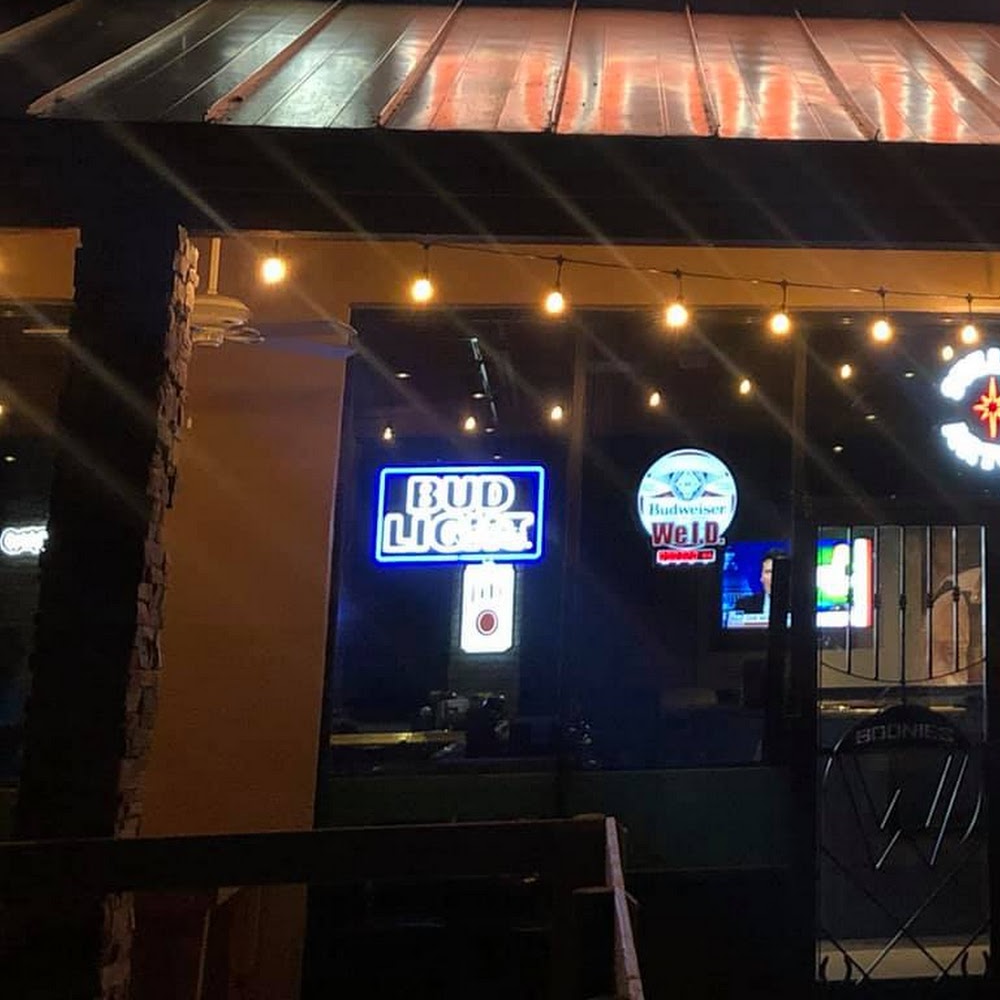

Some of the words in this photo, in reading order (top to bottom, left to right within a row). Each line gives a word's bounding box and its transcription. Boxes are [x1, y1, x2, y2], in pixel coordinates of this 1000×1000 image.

[406, 475, 515, 513] BUD
[649, 503, 727, 516] Budweiser
[651, 521, 688, 545] We
